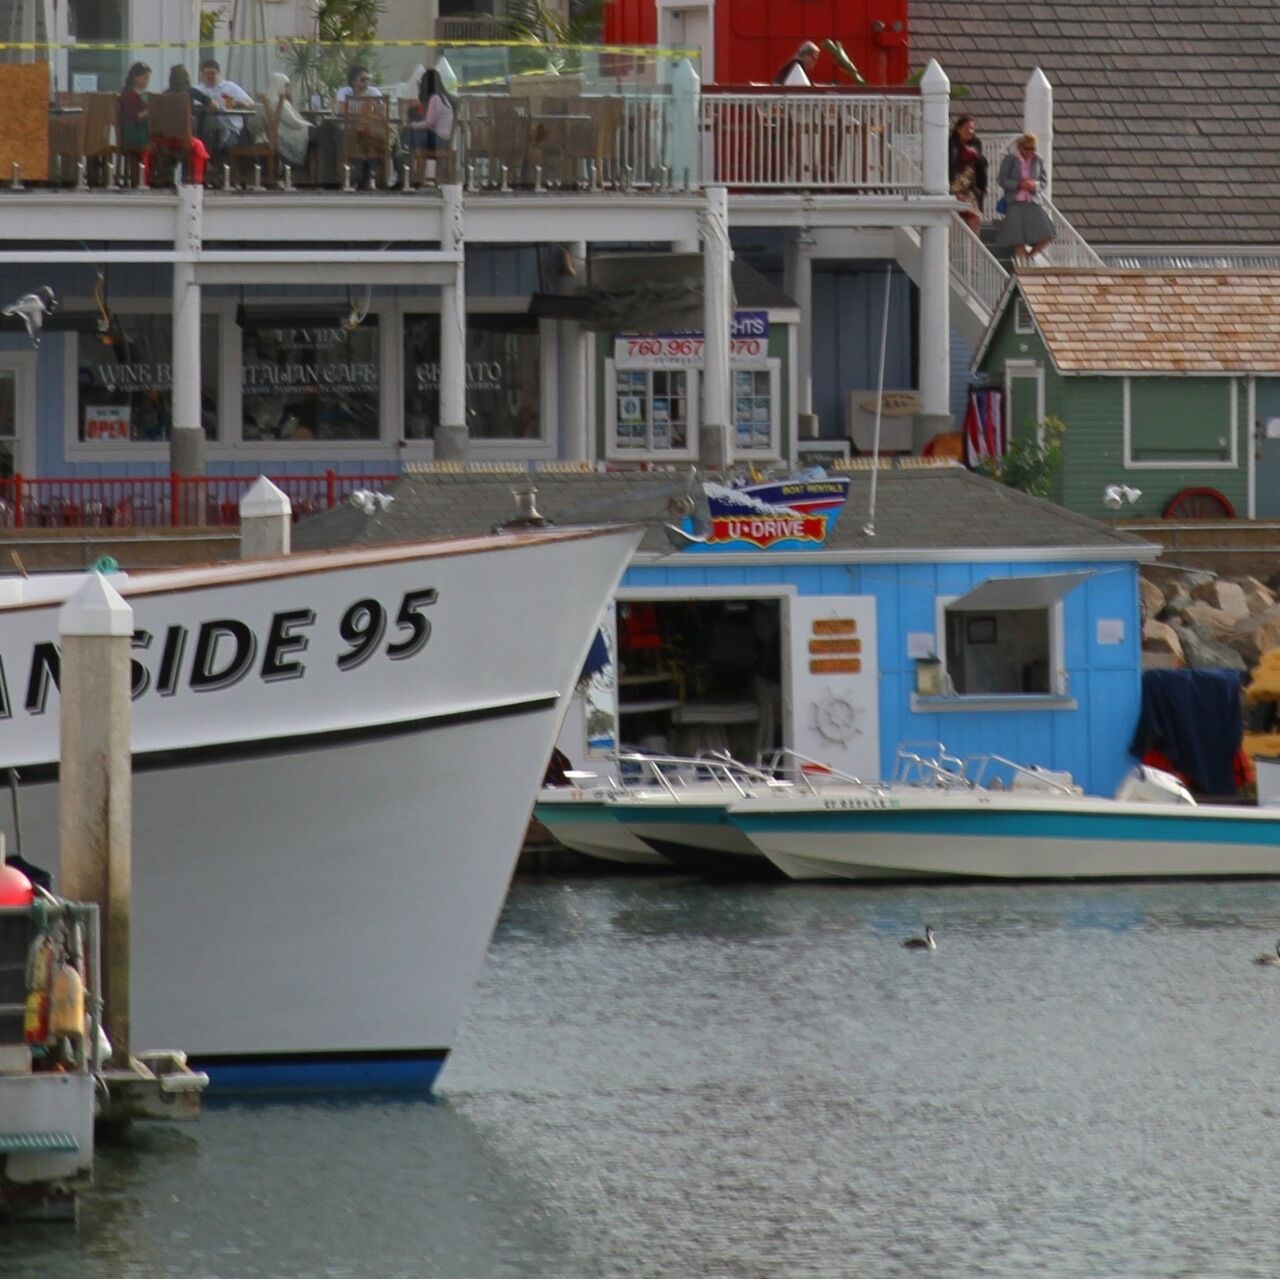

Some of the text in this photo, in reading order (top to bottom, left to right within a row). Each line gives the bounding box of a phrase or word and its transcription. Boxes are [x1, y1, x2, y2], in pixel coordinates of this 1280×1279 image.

[416, 362, 502, 382] GEATO
[86, 420, 129, 439] OPEN
[782, 483, 844, 495] BOAT RENTALS
[336, 587, 439, 672] 95
